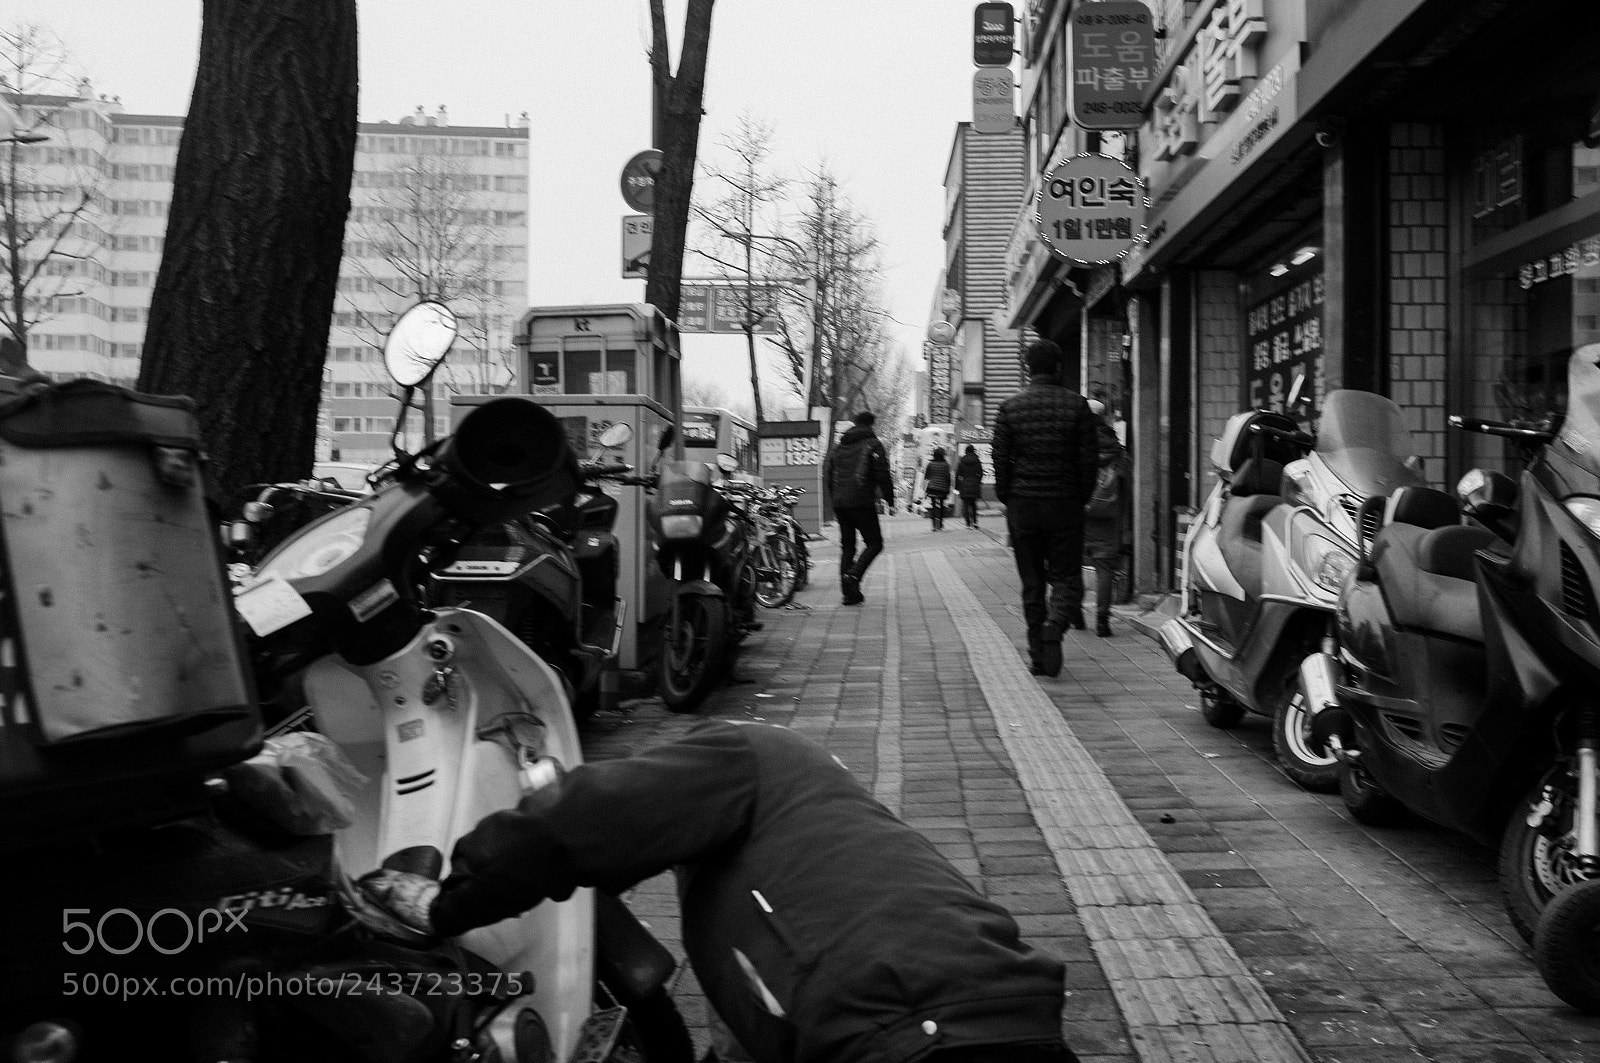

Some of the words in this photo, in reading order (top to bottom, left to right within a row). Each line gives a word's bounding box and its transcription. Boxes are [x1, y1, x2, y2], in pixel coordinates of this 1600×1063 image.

[1080, 30, 1149, 63] 도움
[1075, 66, 1152, 91] 파출부
[1050, 178, 1134, 207] 여인숙
